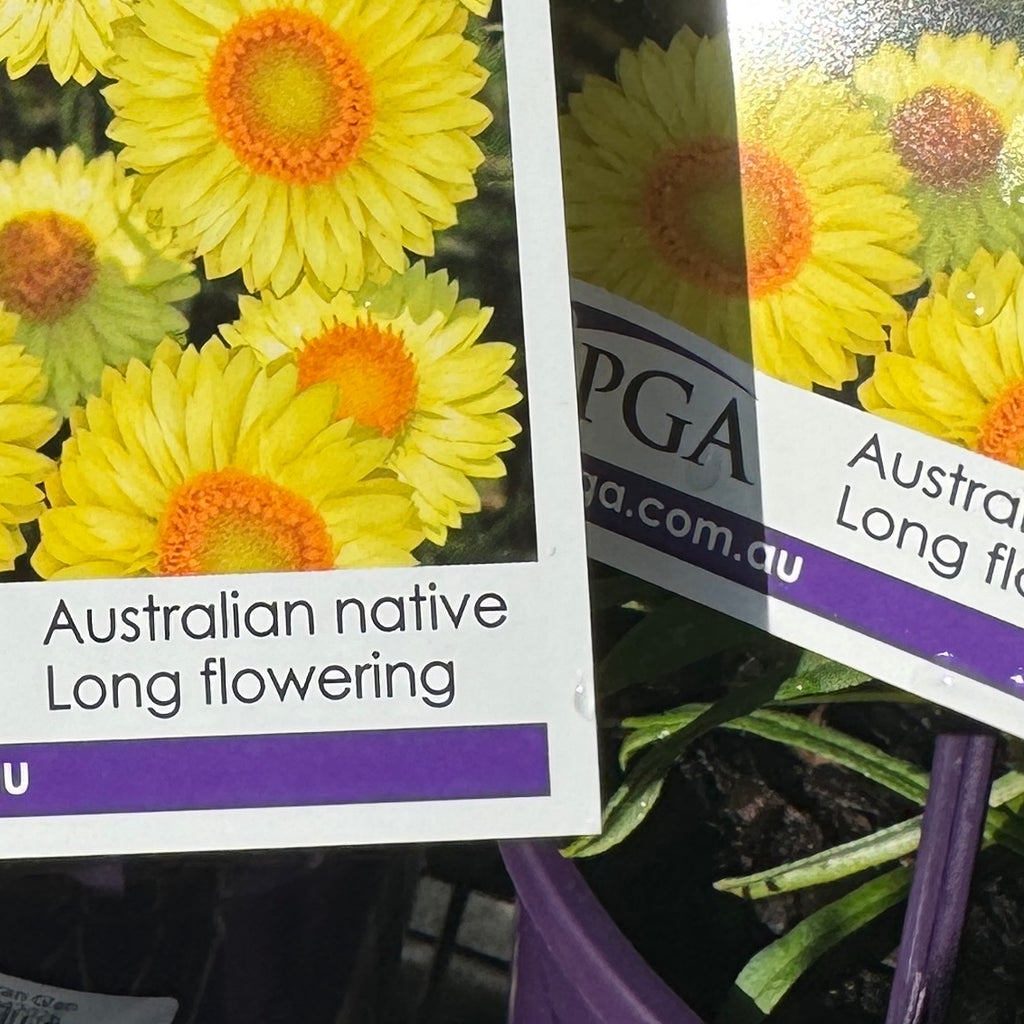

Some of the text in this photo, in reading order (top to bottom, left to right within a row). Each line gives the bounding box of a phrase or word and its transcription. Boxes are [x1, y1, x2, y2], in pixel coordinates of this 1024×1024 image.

[579, 343, 755, 486] PGA
[847, 433, 1024, 533] Austra
[836, 485, 968, 579] Long
[43, 582, 507, 645] Australian native
[47, 651, 455, 719] Long flowering
